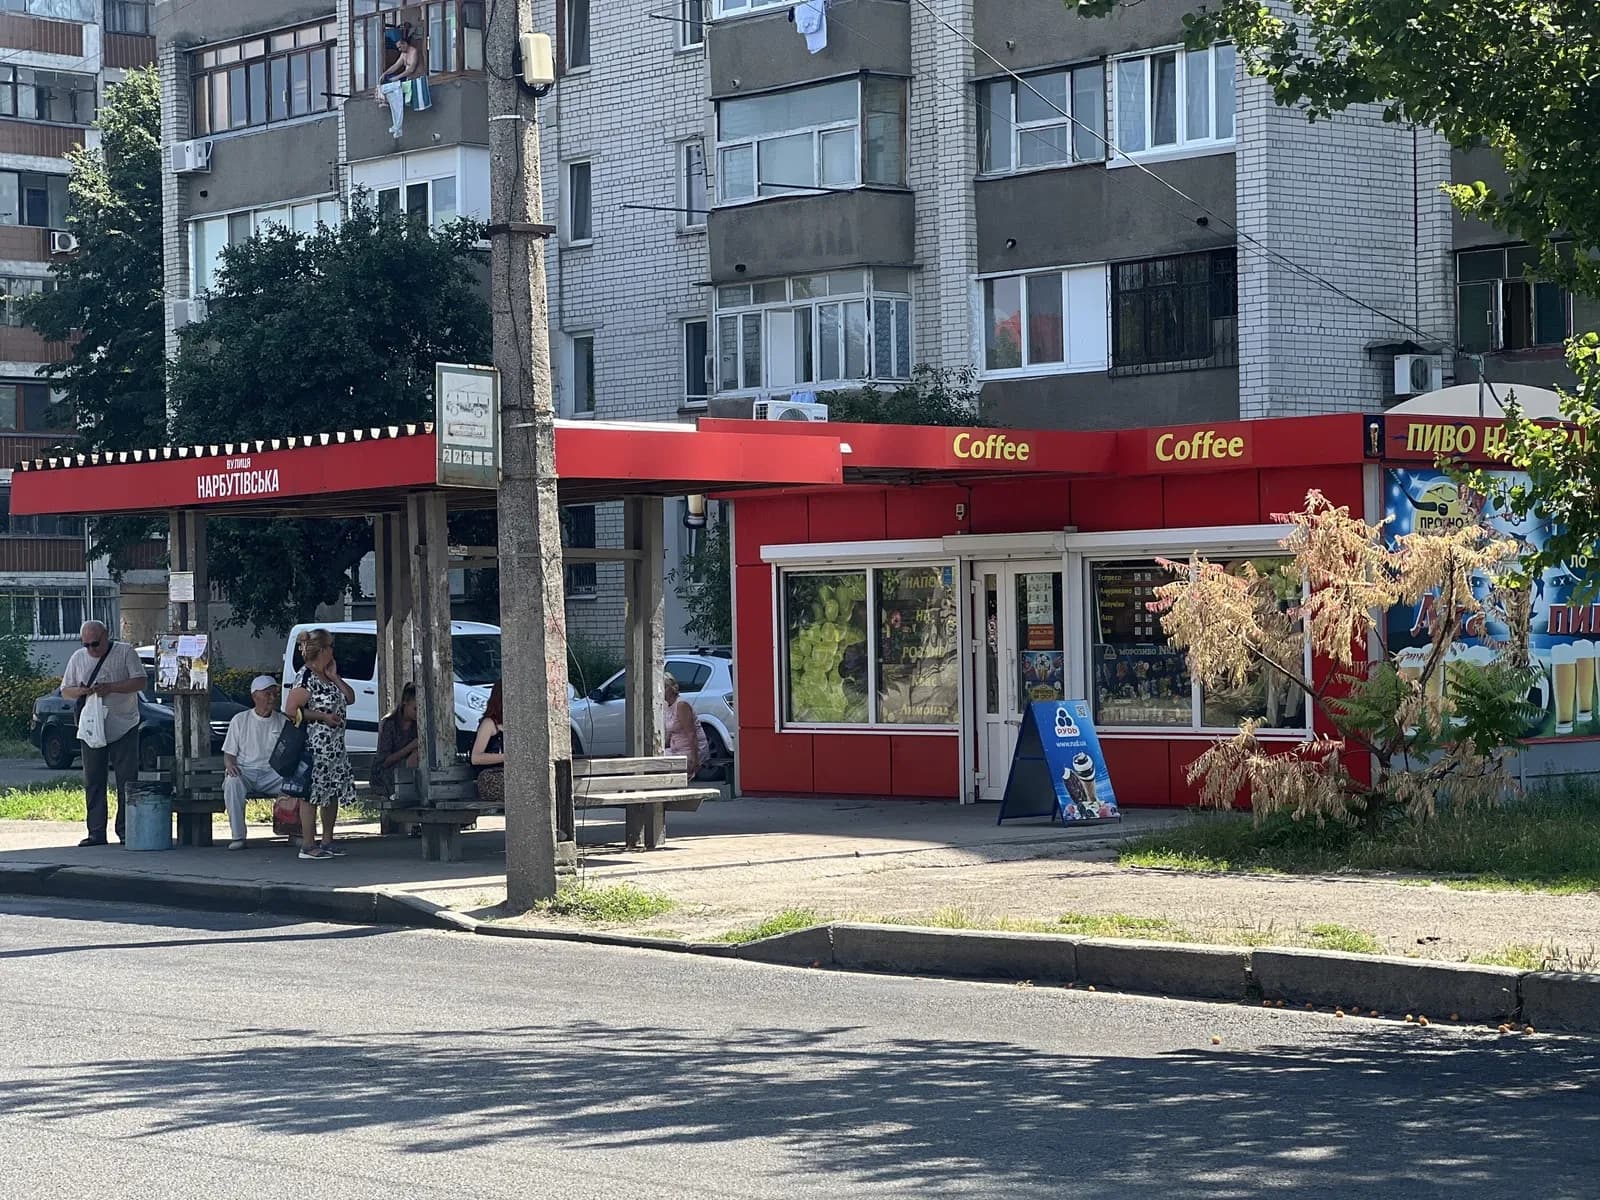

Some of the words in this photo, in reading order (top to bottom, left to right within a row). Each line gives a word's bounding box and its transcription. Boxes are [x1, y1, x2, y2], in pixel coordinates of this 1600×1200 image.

[953, 432, 1030, 461] Coffee
[1155, 430, 1244, 462] Coffee
[1406, 423, 1477, 453] ПИВО
[226, 457, 251, 470] ВУЛИЦЯ
[197, 469, 279, 498] НАРБУТІВСЬКА
